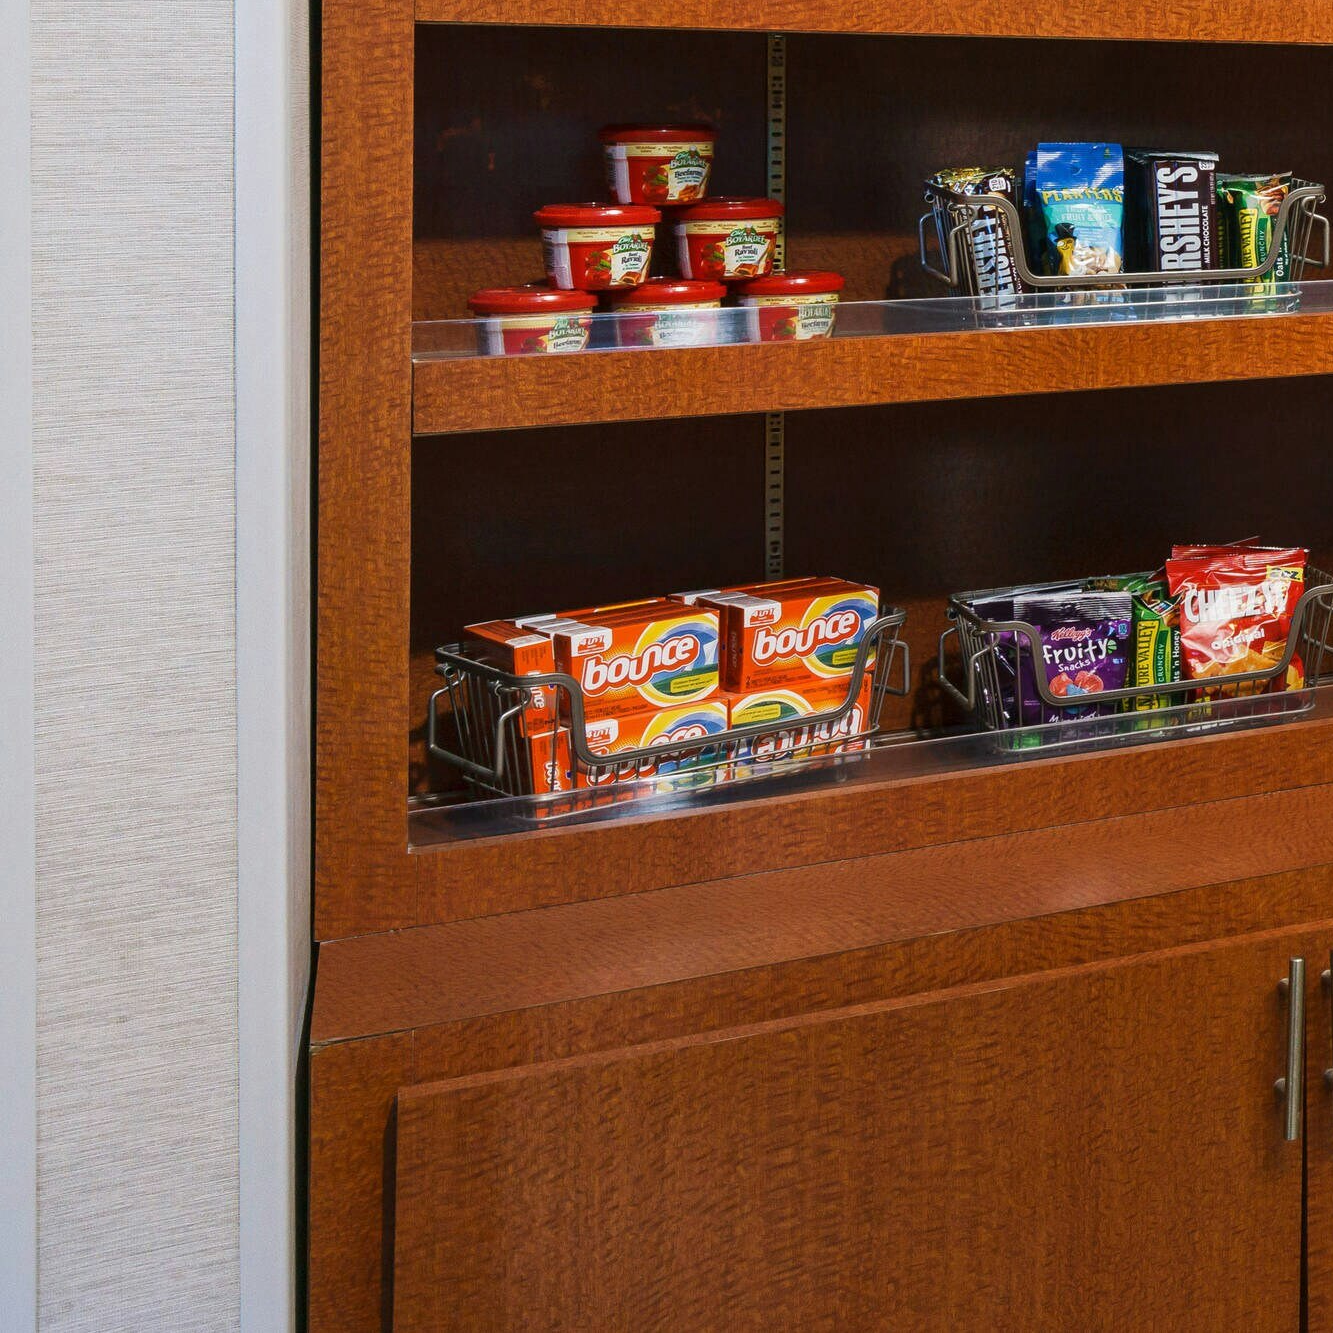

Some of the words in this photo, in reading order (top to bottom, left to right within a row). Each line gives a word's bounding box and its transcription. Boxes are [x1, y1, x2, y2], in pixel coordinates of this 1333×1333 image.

[1156, 165, 1202, 271] RSHEY'S
[1202, 205, 1210, 246] CHOCOLATE
[1239, 212, 1254, 250] VALLEY
[1202, 246, 1210, 264] MILK
[1258, 229, 1266, 262] RUNCHY
[756, 612, 857, 660] bounce
[1051, 626, 1092, 641] Kellogg's
[1138, 622, 1156, 662] VALLEY
[1171, 630, 1181, 658] Honey
[585, 636, 696, 689] bounce
[1057, 659, 1091, 673] Snacks
[1157, 643, 1165, 683] CRUNCHY
